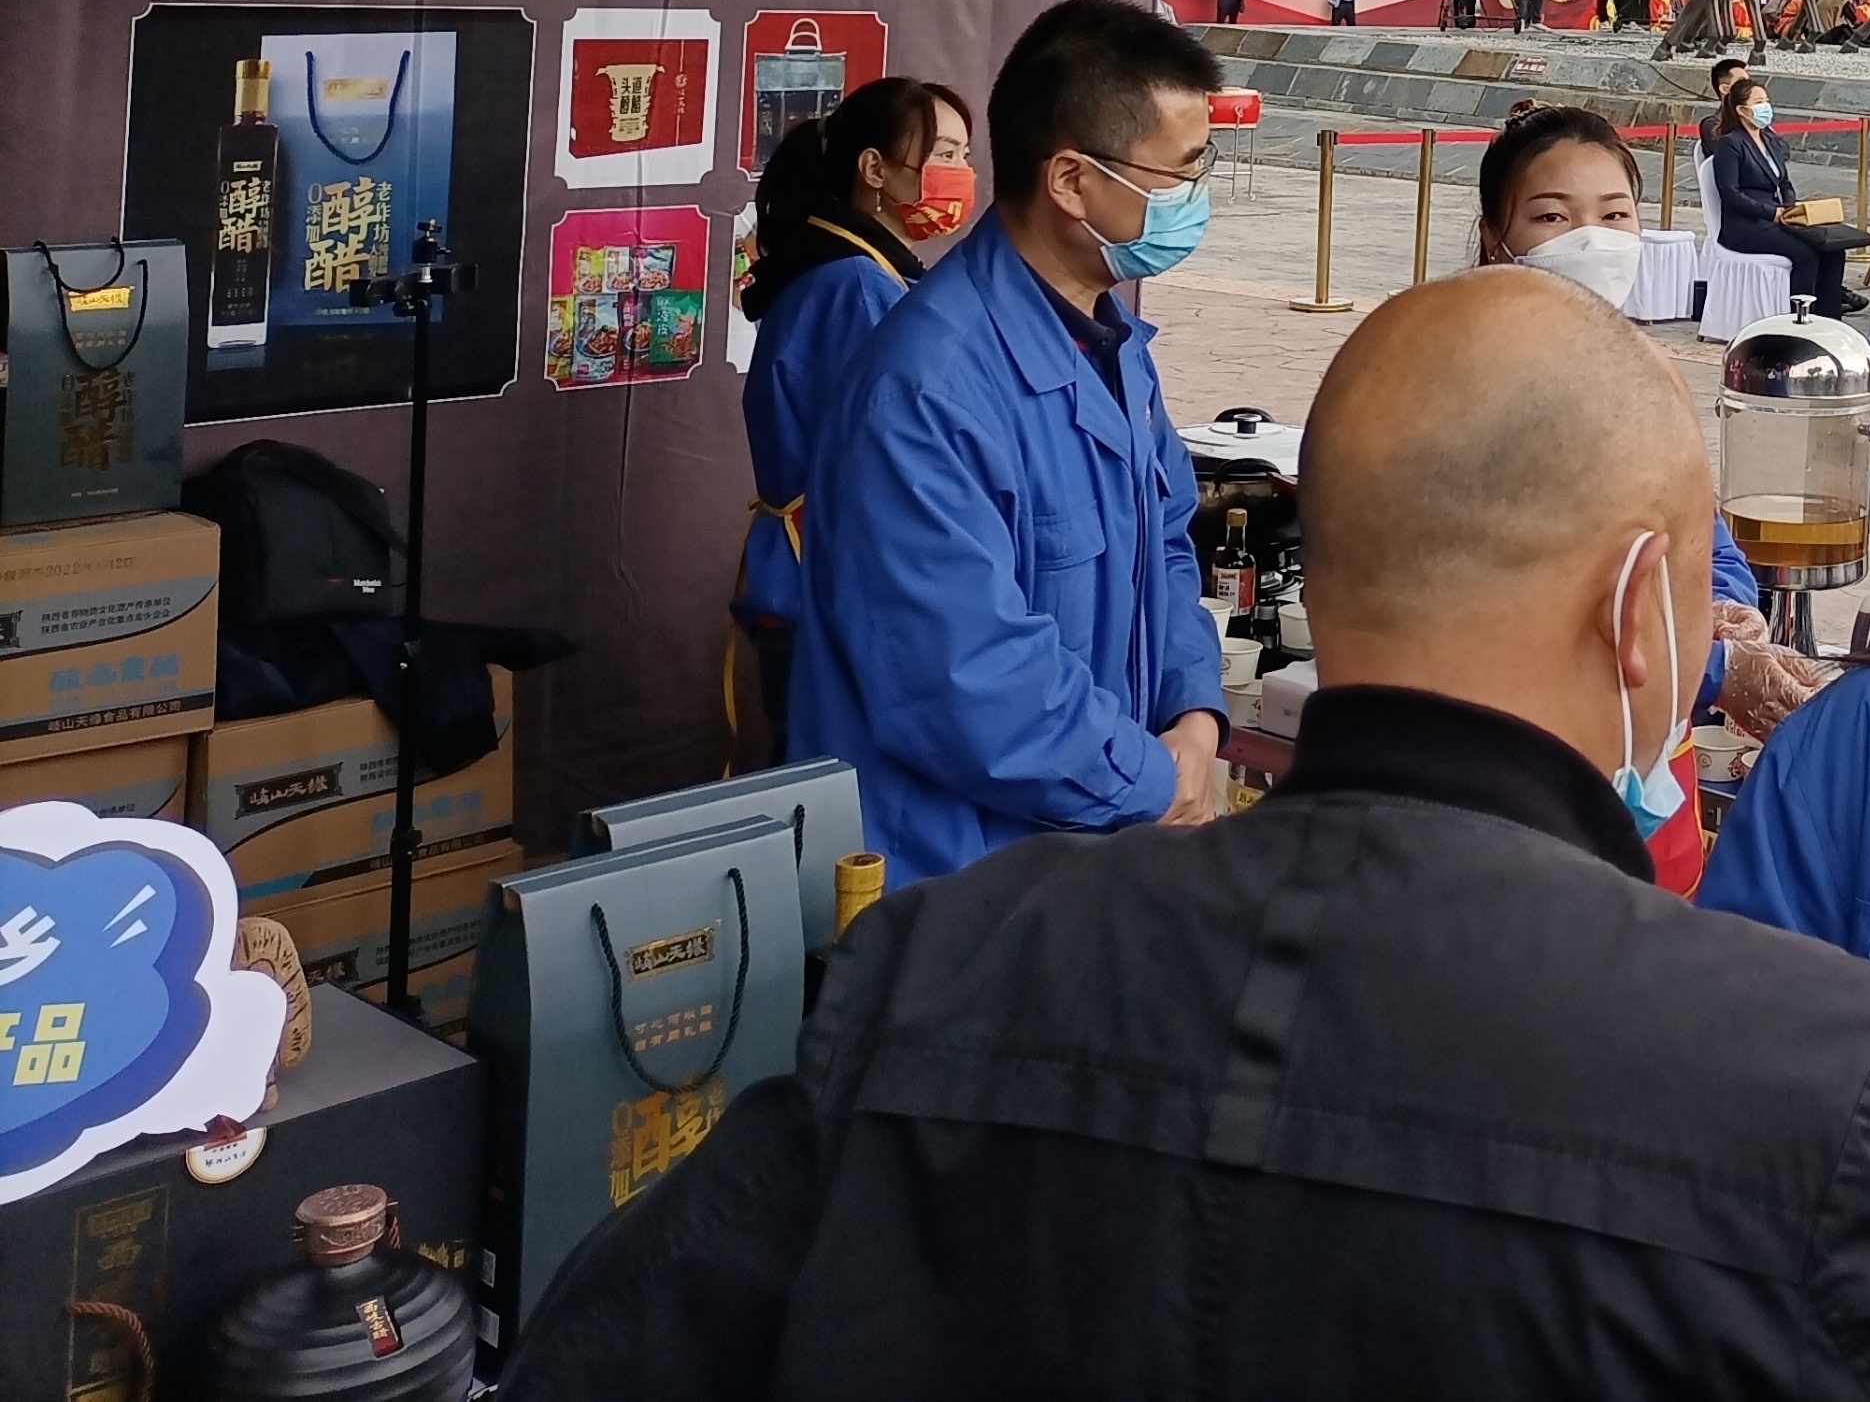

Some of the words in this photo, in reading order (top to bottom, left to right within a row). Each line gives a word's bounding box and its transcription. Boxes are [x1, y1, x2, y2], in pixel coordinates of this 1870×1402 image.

[217, 176, 266, 254] 醇醋
[304, 176, 378, 293] 醇醋
[249, 774, 329, 806] 岐山天缘
[634, 936, 707, 974] 岐山天缘
